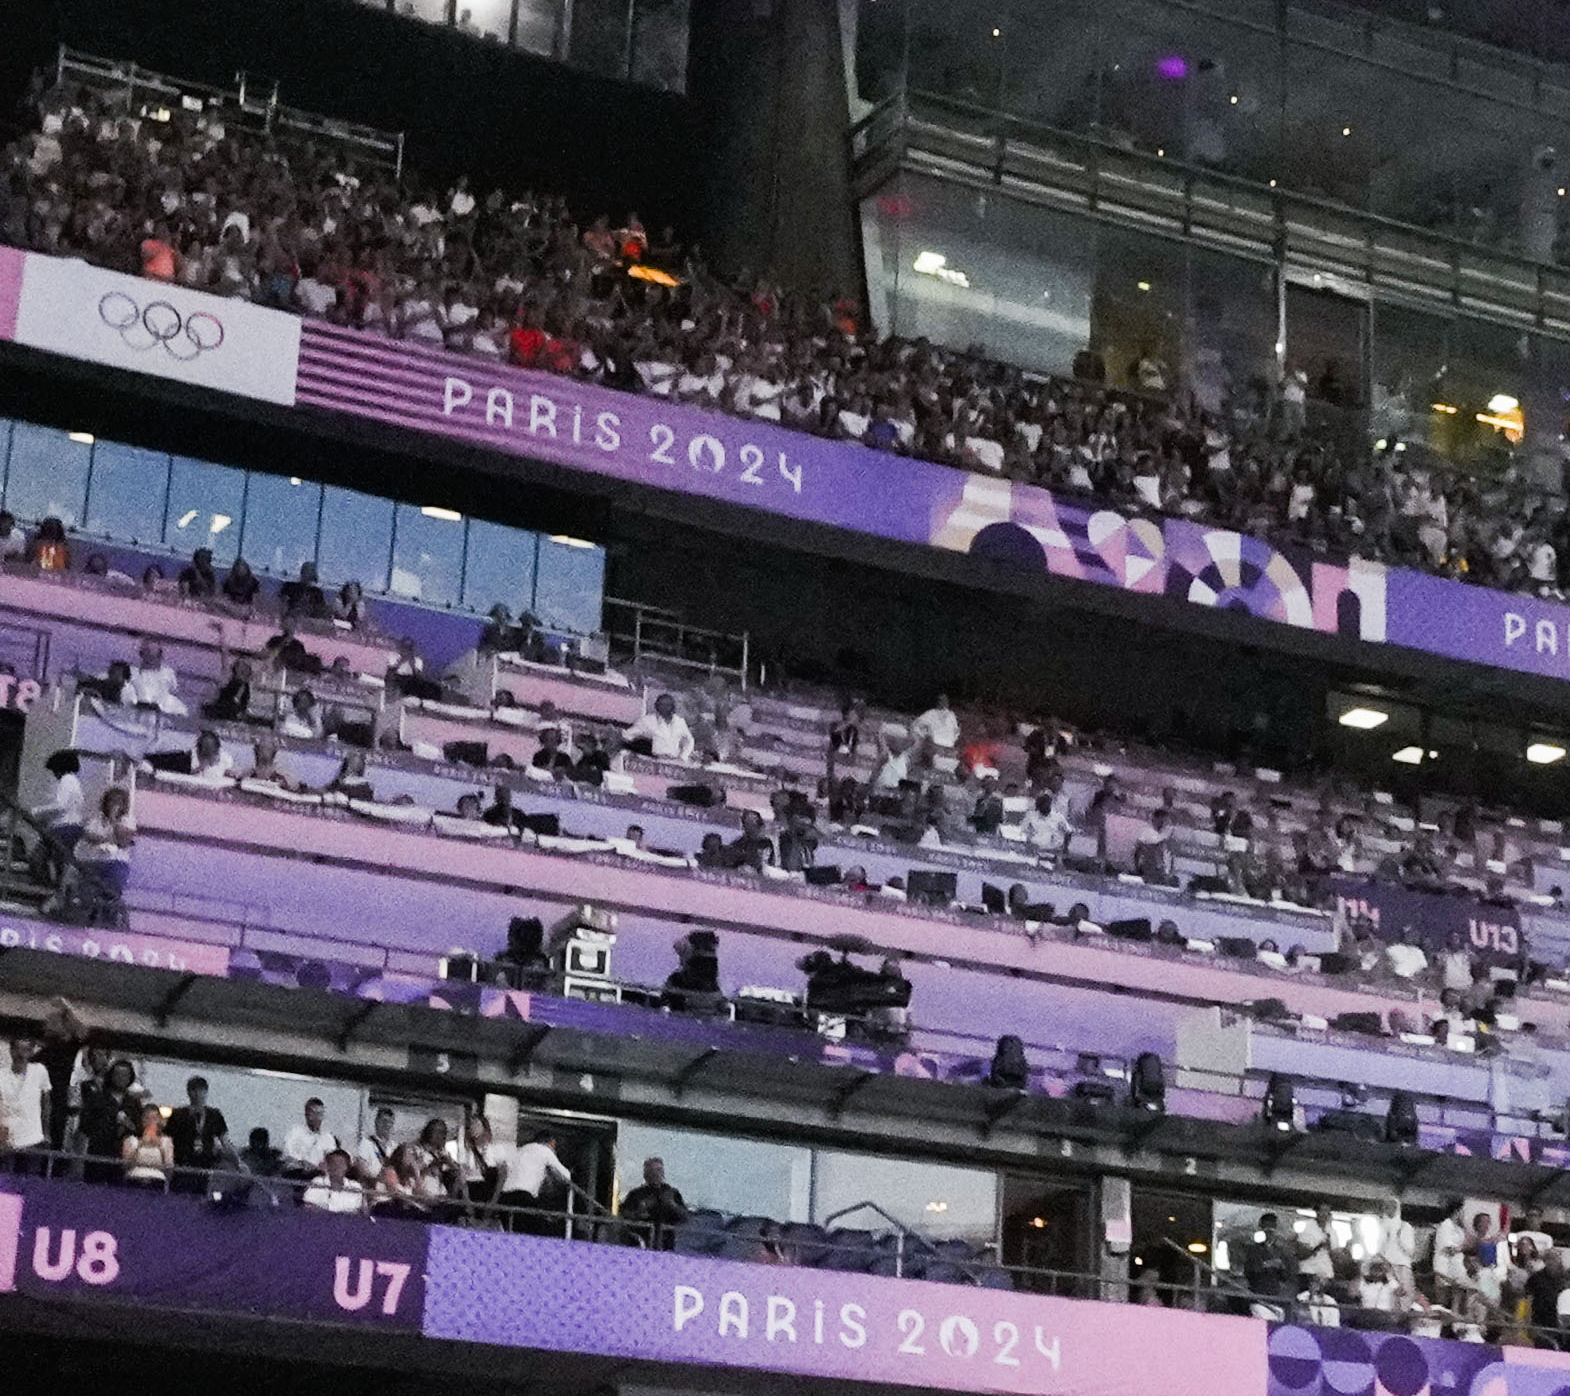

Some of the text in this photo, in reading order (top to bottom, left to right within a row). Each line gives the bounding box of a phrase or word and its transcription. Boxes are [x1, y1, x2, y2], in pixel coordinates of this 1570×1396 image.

[443, 376, 803, 494] PARIS 2024
[32, 1225, 412, 1316] U8 U7
[673, 1284, 1062, 1370] PARIS 2024
